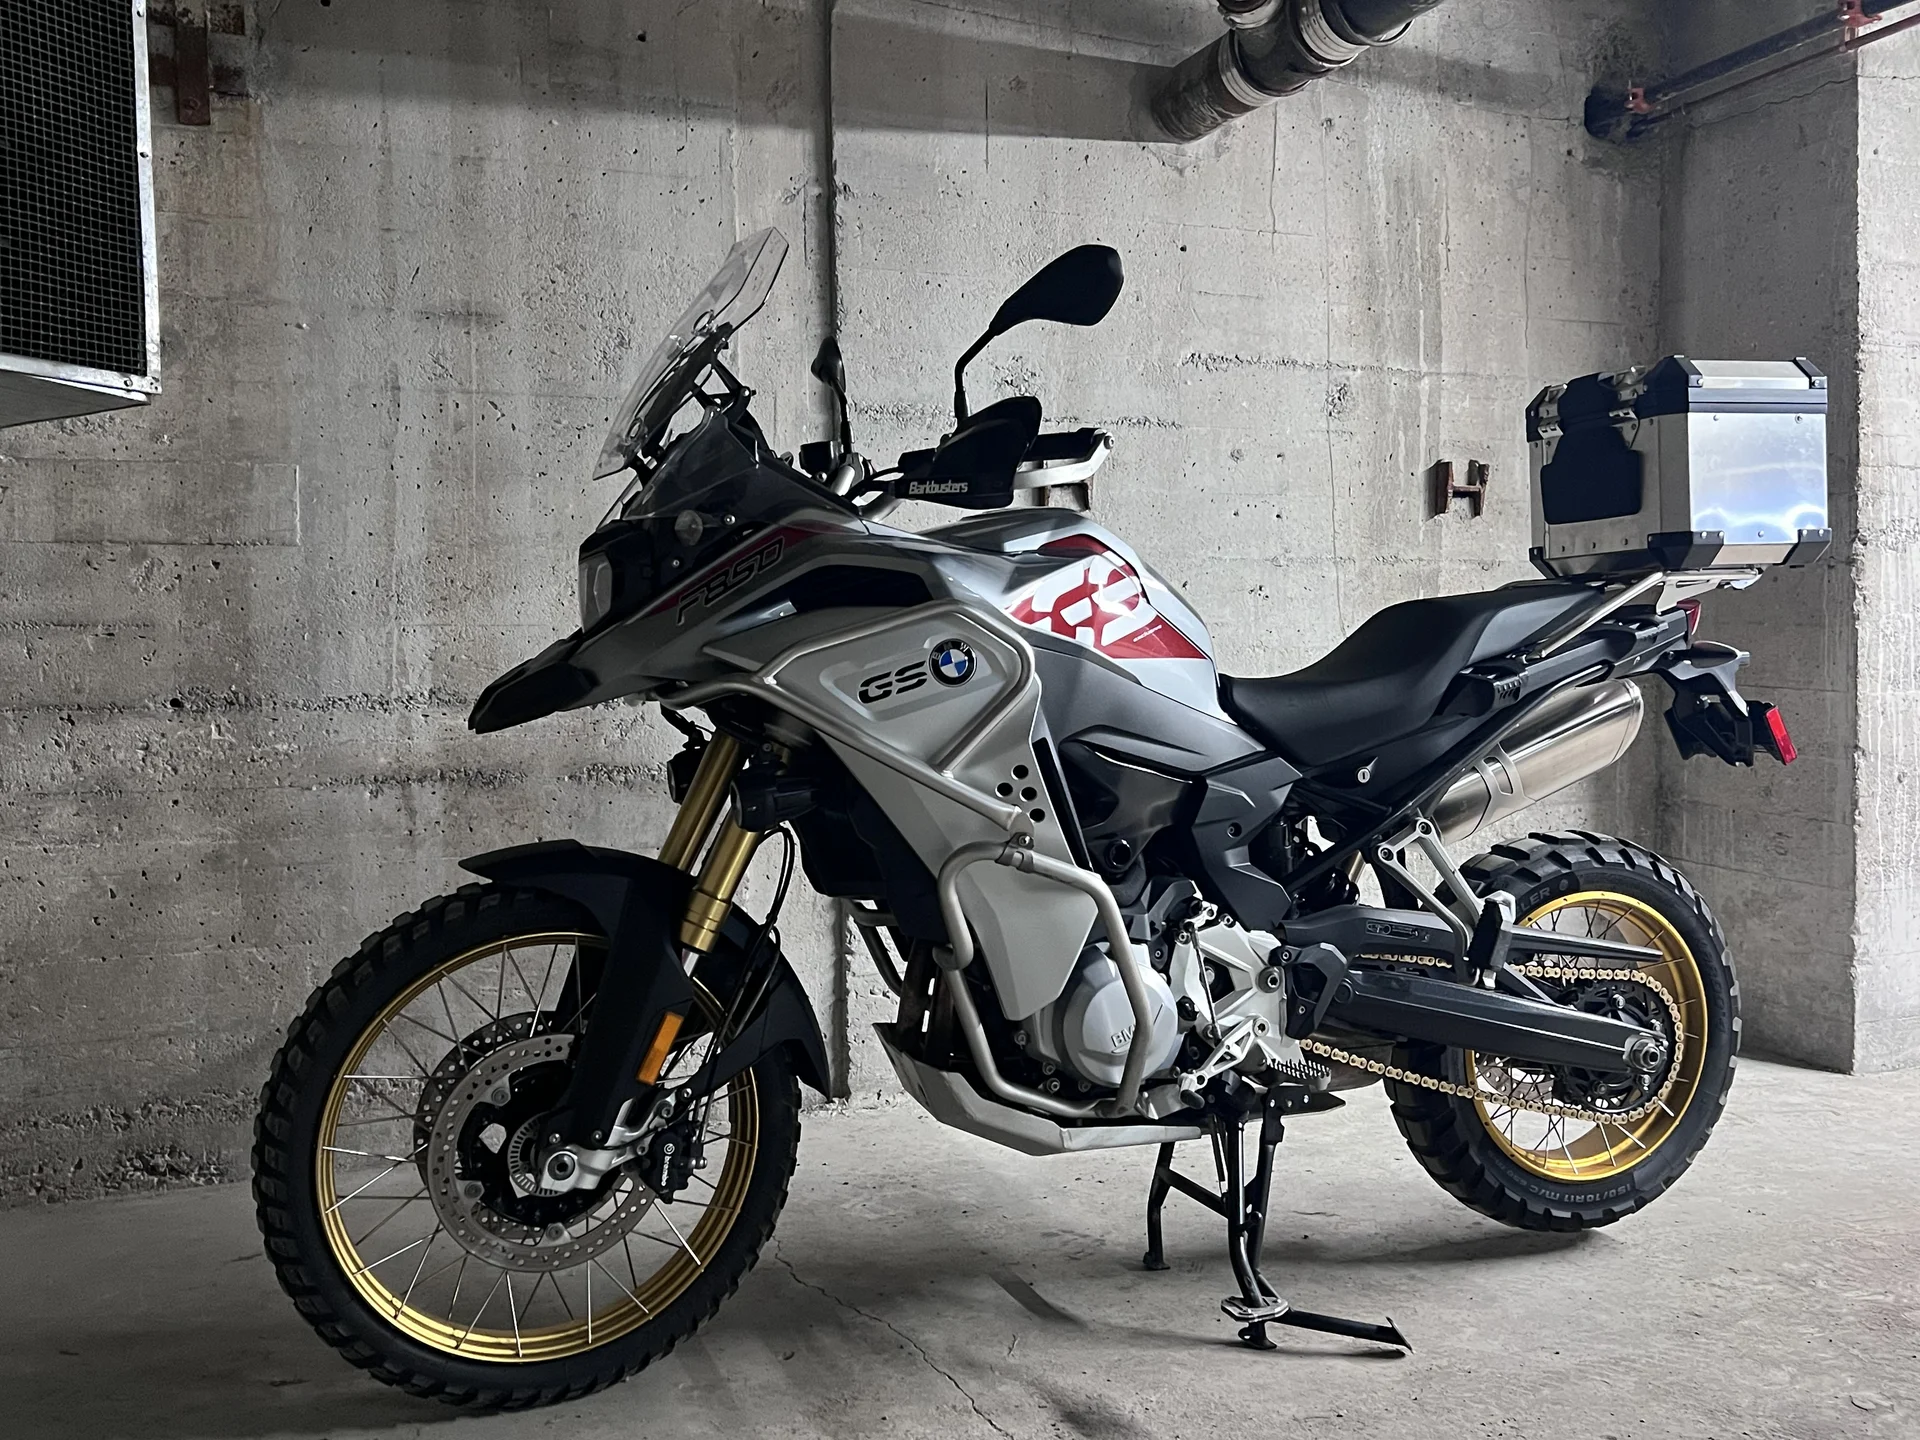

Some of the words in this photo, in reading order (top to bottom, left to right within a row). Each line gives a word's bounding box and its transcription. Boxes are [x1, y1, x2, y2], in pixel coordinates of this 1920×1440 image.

[908, 480, 968, 495] Barkbusters
[858, 660, 928, 704] GS
[661, 1155, 672, 1187] brembo
